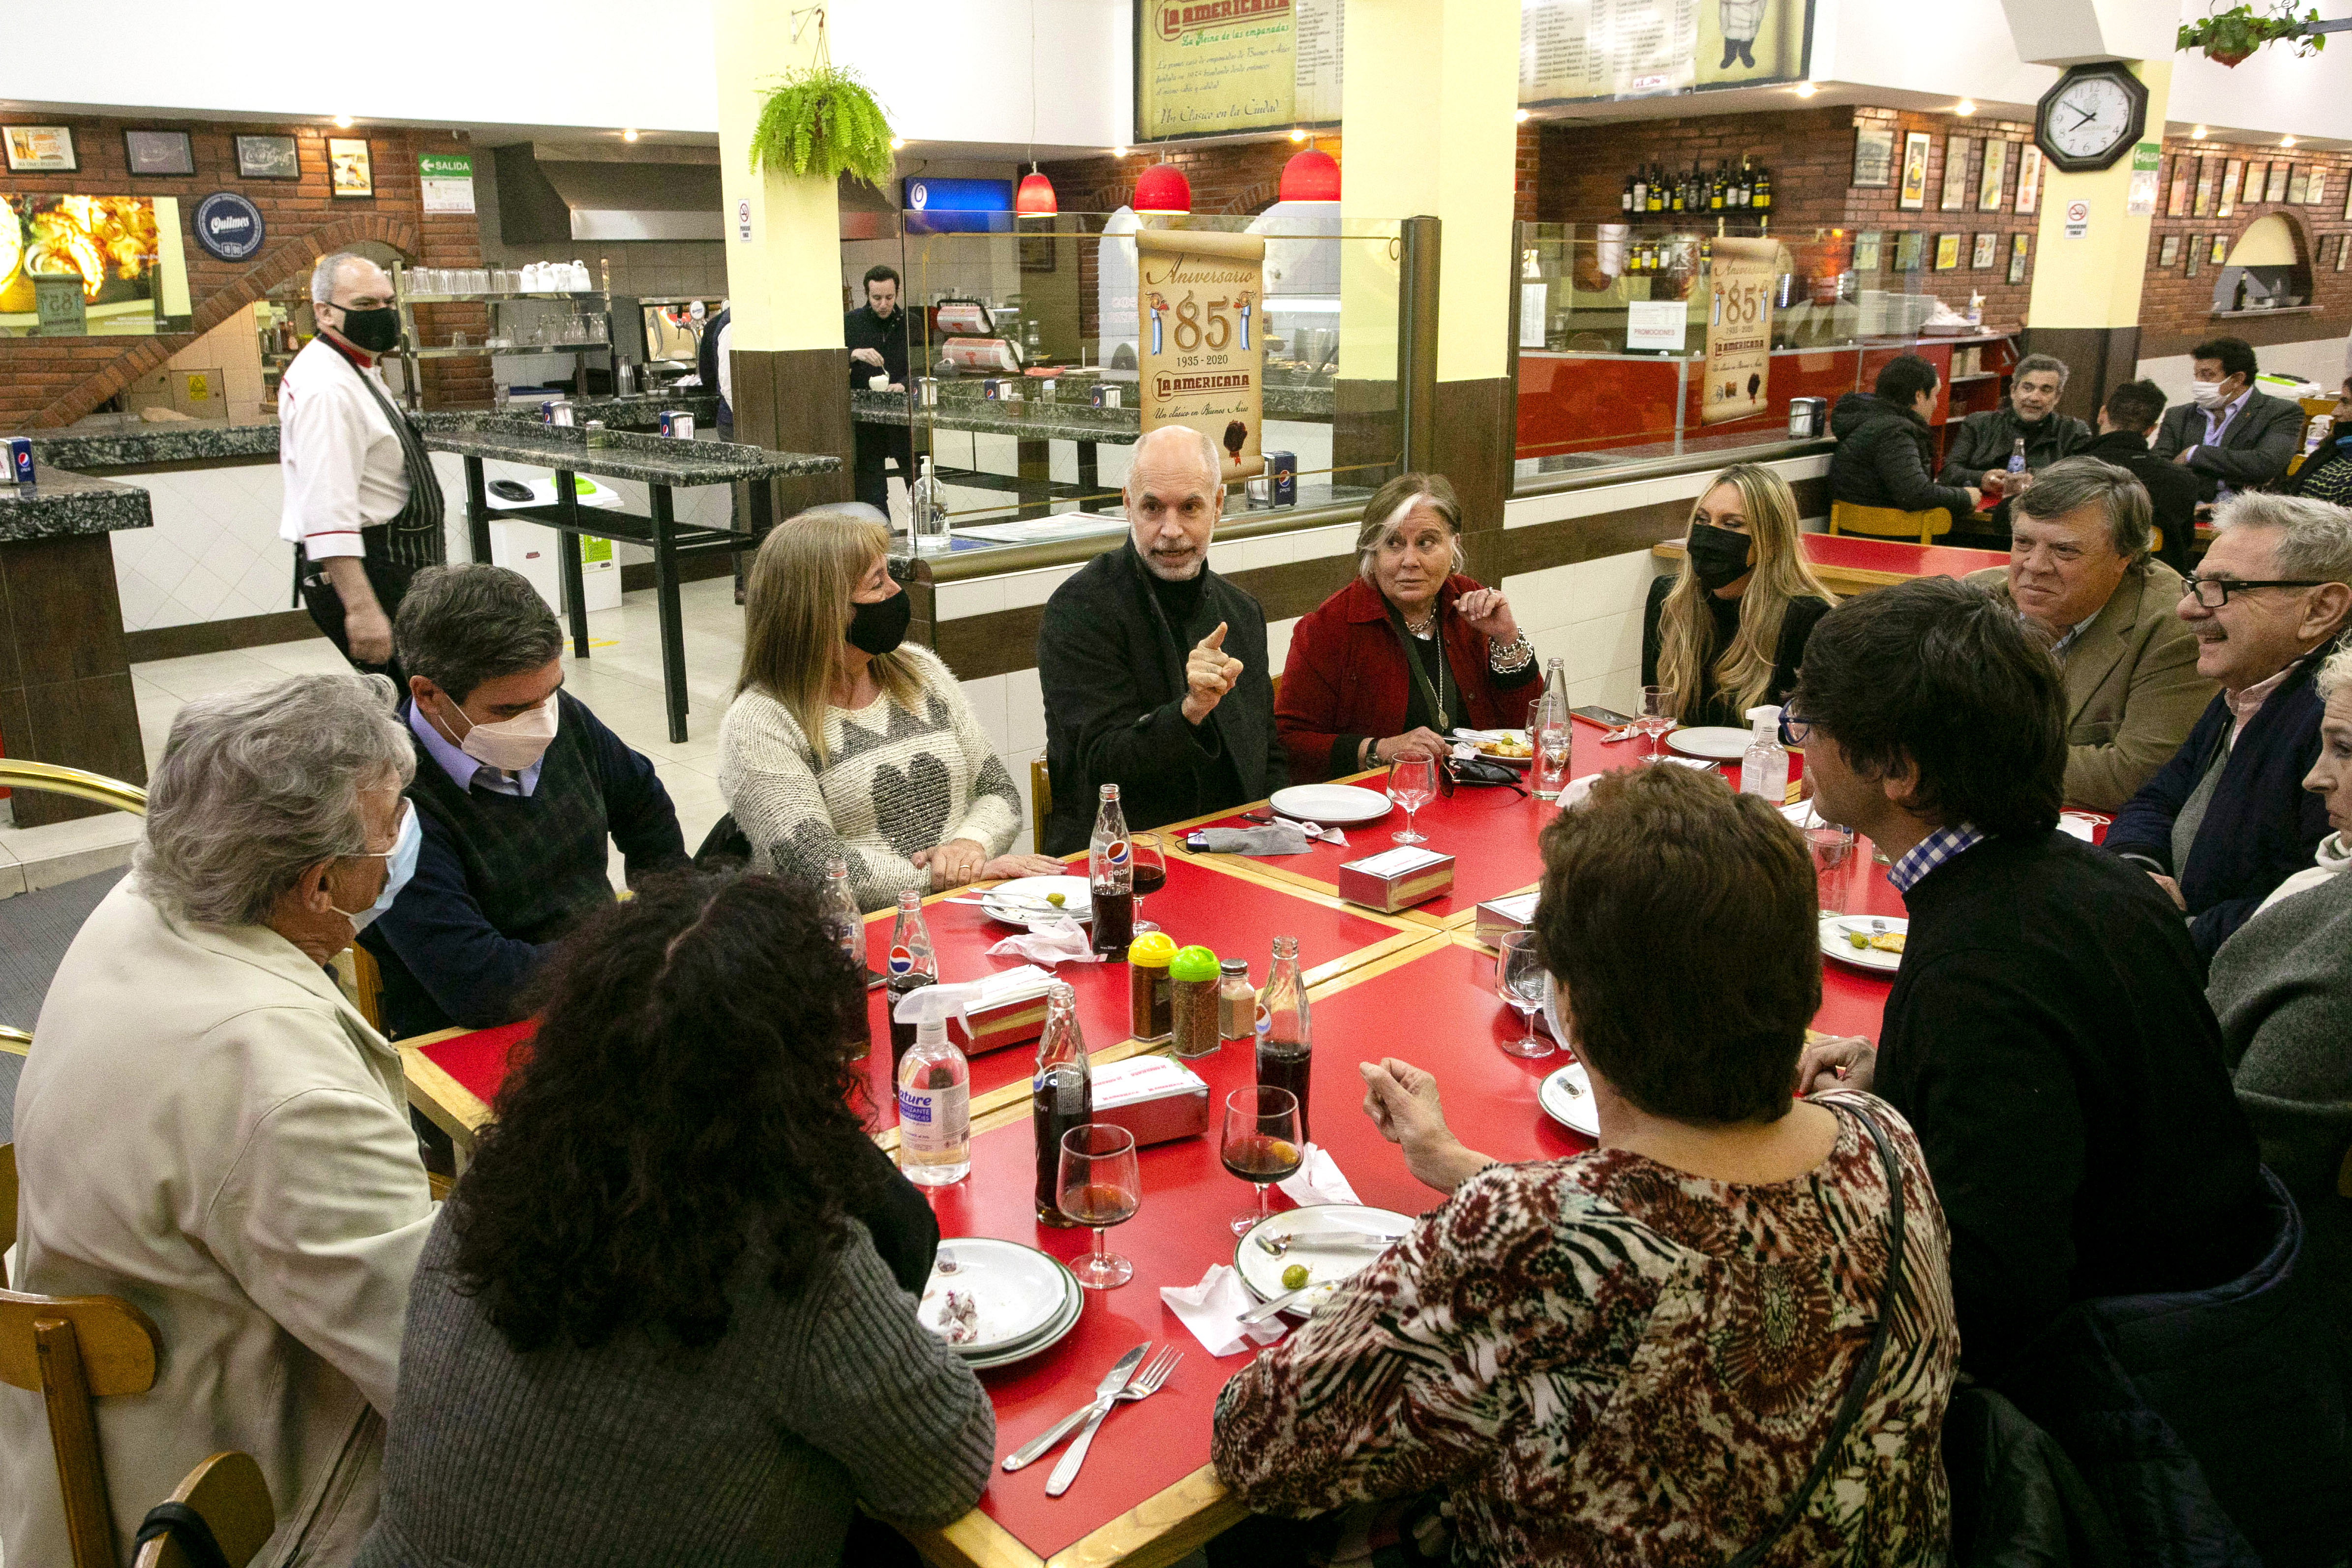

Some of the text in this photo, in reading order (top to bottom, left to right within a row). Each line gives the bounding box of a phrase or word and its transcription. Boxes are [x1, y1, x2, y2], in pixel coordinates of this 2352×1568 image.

[1221, 31, 1230, 40] de
[1232, 30, 1243, 38] las
[1245, 23, 1289, 38] empanadas
[2090, 82, 2100, 92] 12
[2117, 94, 2124, 105] 2
[1230, 105, 1240, 117] la
[2120, 110, 2127, 120] 3
[2056, 114, 2063, 123] 9
[2112, 126, 2119, 136] 4
[2067, 139, 2075, 151] 7
[2082, 142, 2089, 152] 6
[2100, 137, 2107, 147] 5
[435, 161, 470, 171] SALIDA
[211, 216, 249, 234] Quilmes
[1146, 252, 1255, 284] Aniversario
[1726, 279, 1756, 324] 85
[1174, 290, 1232, 352] 85
[1723, 340, 1763, 351] AMERICANA
[1177, 356, 1198, 367] 1935
[1206, 355, 1228, 364] 2020
[1174, 374, 1250, 390] AMERICANA
[1154, 407, 1167, 419] Un
[1201, 402, 1225, 416] Buenos
[1227, 401, 1248, 413] Aires
[1108, 866, 1129, 877] pepsi
[900, 1089, 932, 1106] ature
